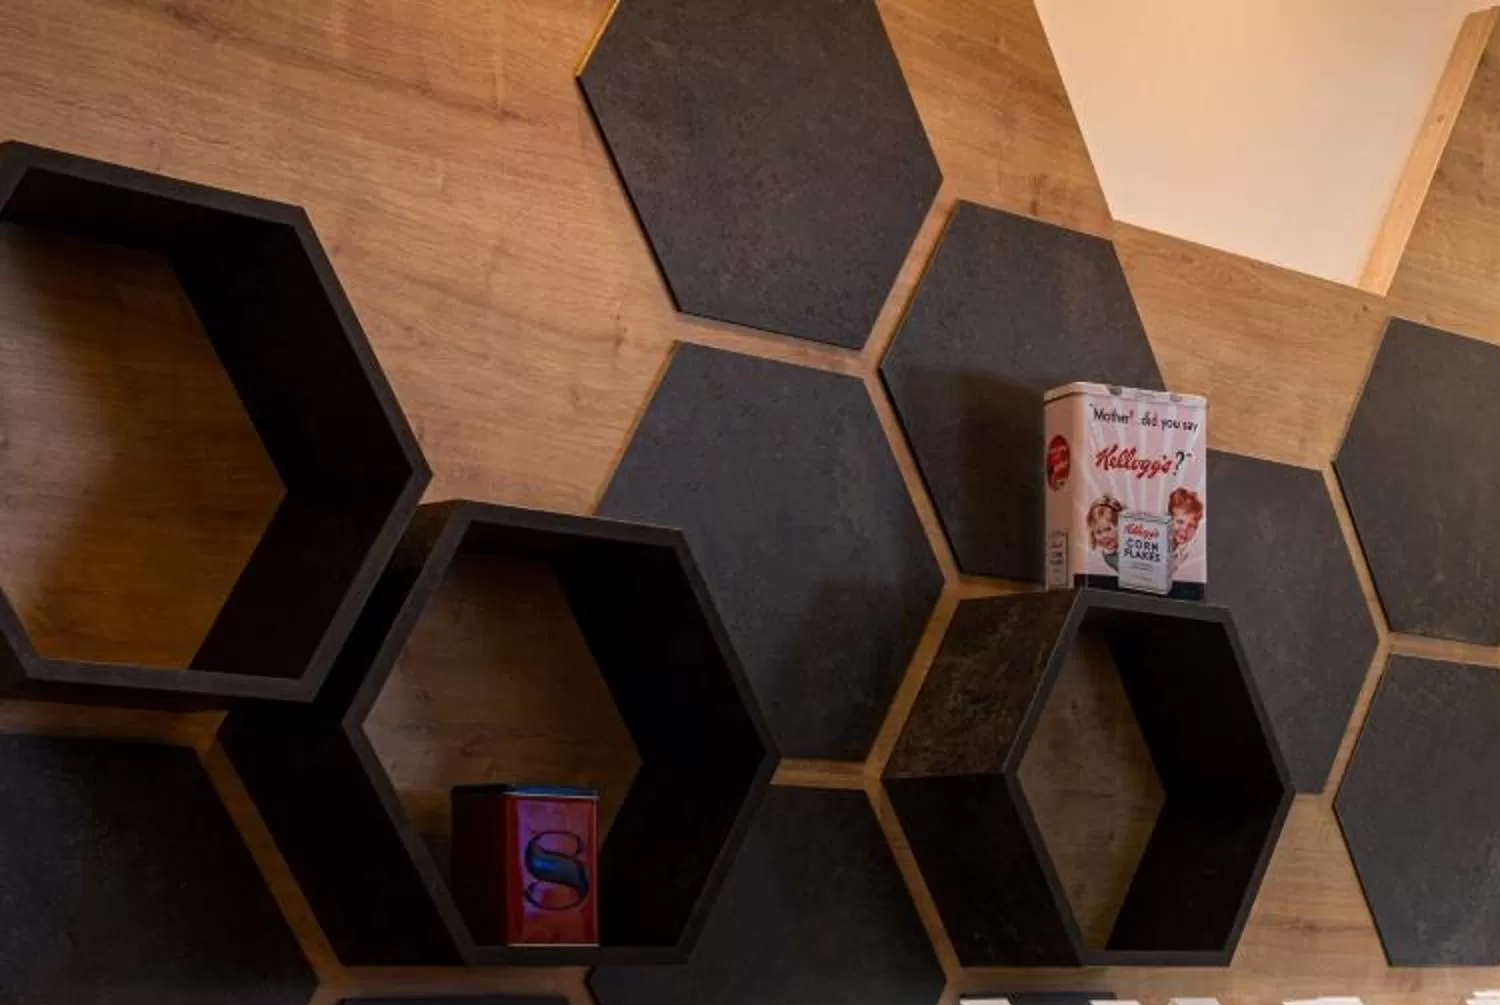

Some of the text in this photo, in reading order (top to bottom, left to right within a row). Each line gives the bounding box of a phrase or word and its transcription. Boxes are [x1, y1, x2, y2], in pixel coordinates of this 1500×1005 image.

[1141, 411, 1159, 428] did
[1162, 418, 1181, 432] you
[1182, 421, 1199, 433] say
[1126, 538, 1160, 553] CORN
[1123, 547, 1161, 563] FLAKES
